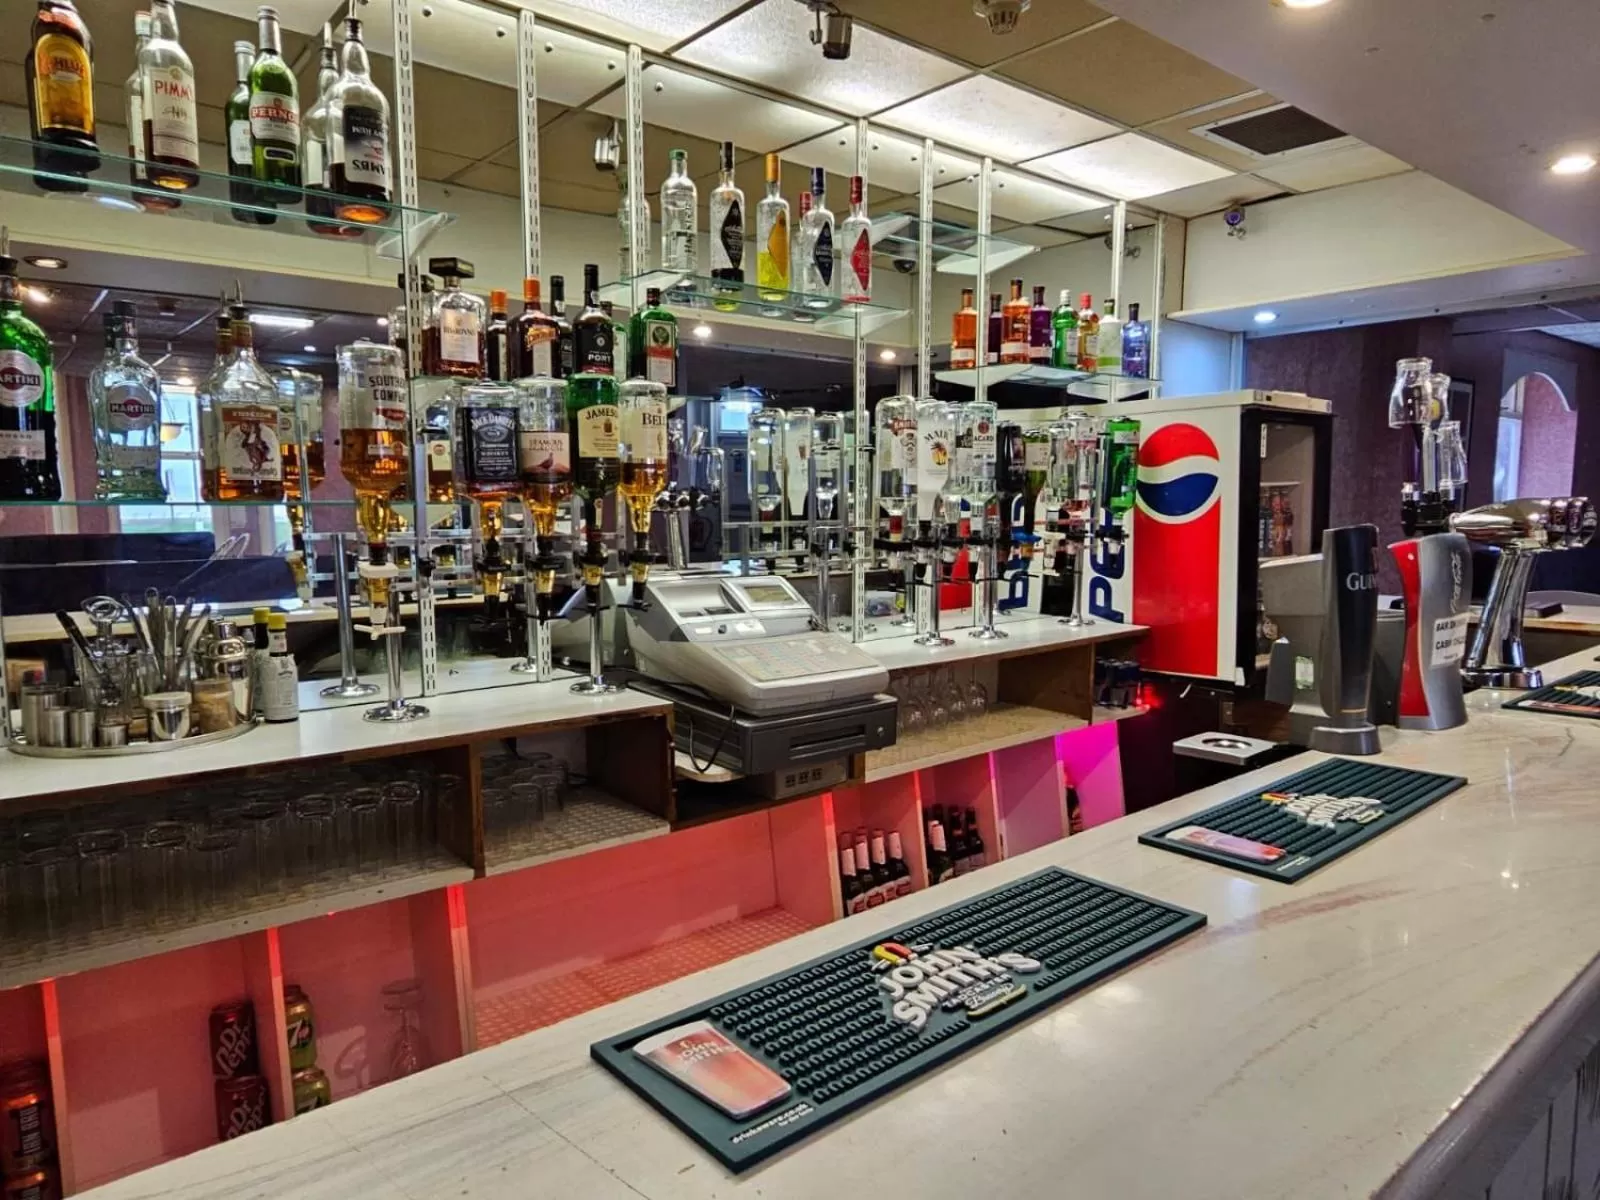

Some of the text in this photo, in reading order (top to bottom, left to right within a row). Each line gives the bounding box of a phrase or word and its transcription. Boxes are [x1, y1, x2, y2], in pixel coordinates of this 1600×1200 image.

[588, 354, 612, 363] PORT
[879, 945, 981, 1000] JOHN
[893, 952, 1041, 1034] SMITH'S
[942, 973, 1012, 1009] TADCASTER
[220, 1022, 242, 1050] Dr
[230, 1100, 252, 1127] Dr
